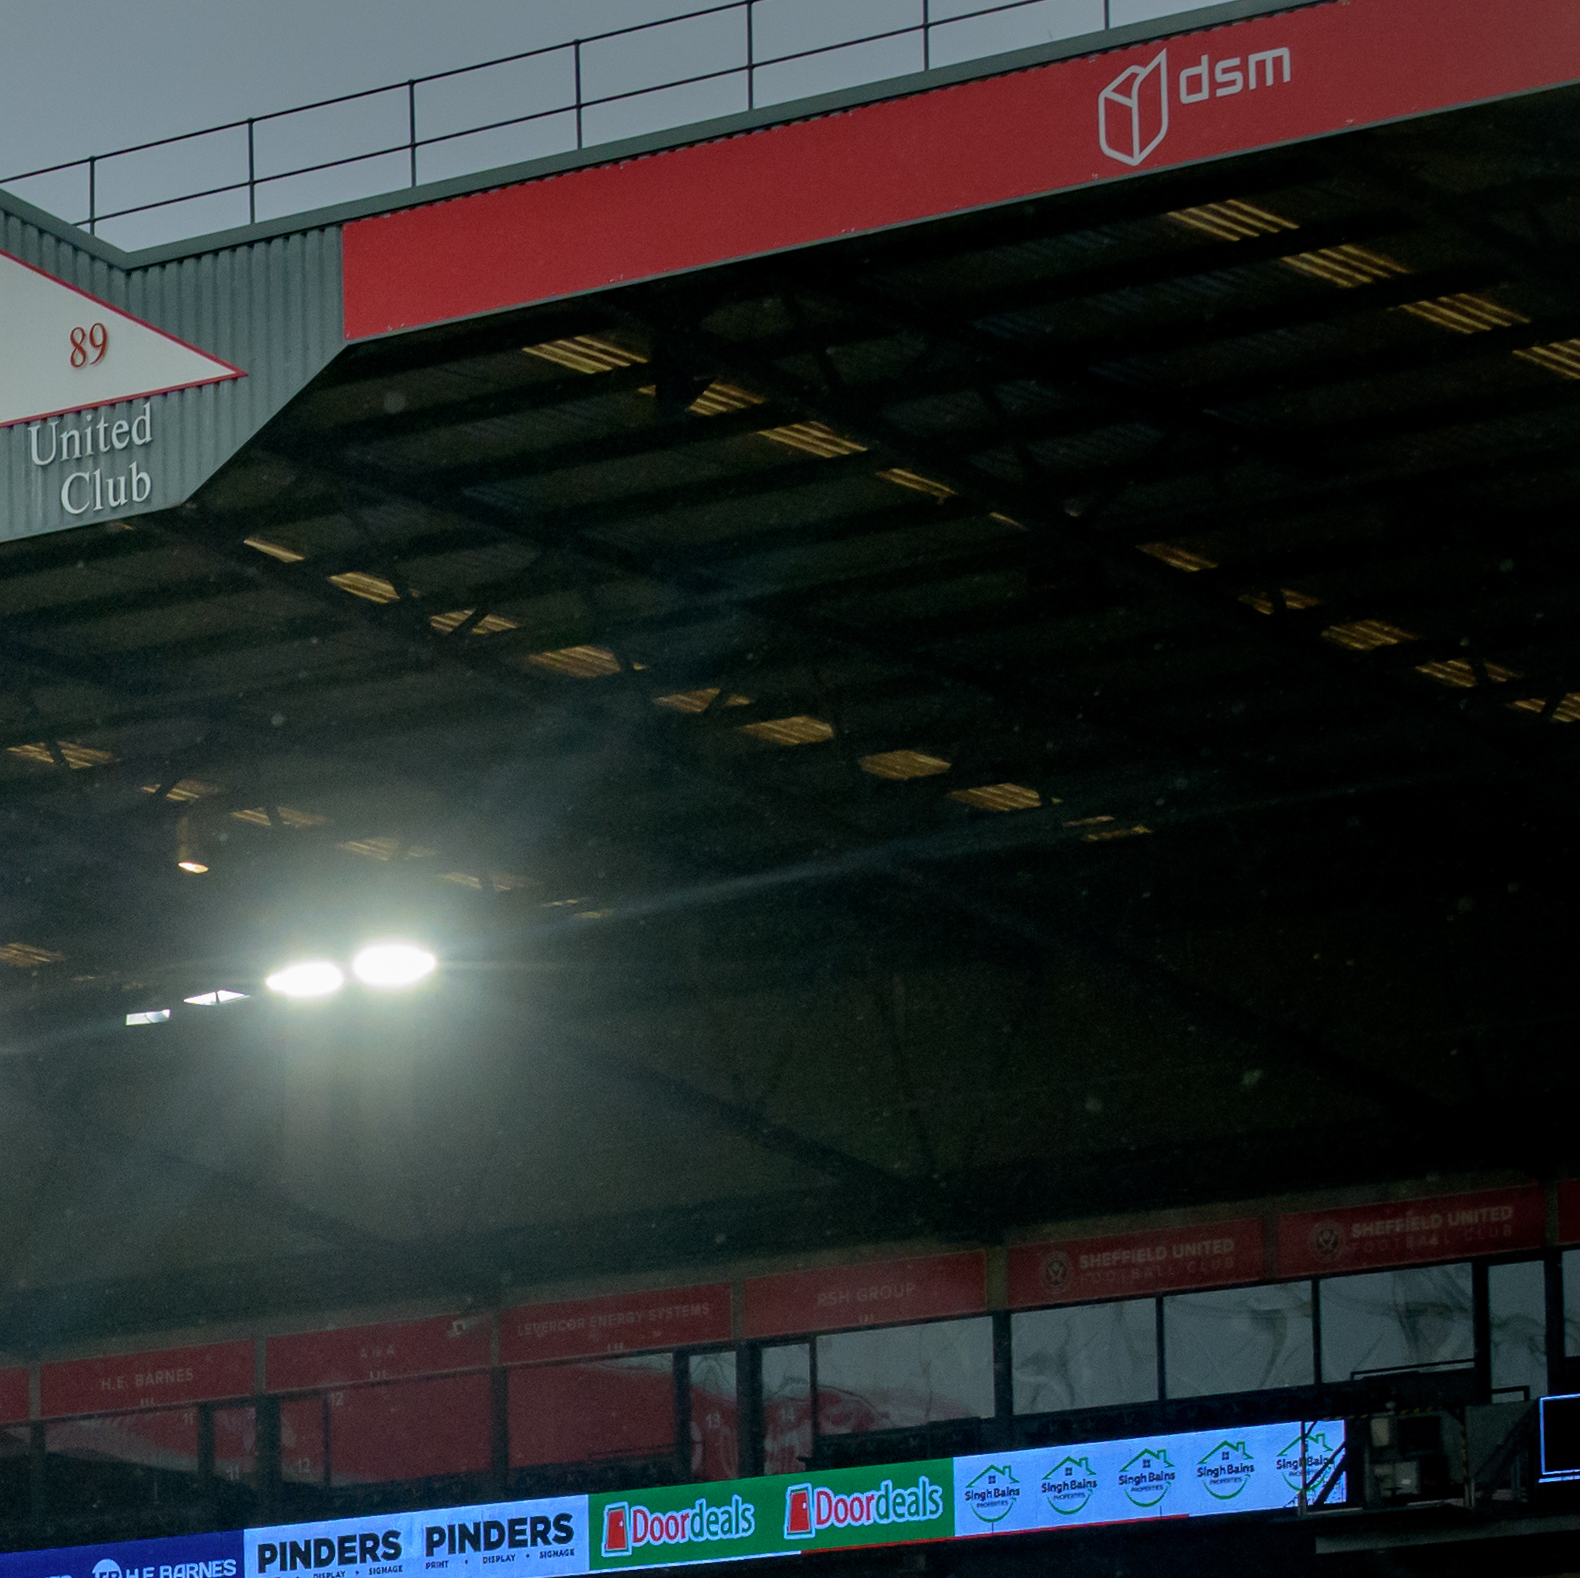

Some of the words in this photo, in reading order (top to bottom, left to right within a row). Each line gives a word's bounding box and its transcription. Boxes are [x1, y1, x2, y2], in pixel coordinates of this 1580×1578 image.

[1179, 47, 1291, 104] dsm
[69, 323, 109, 370] 89
[28, 402, 153, 467] United
[60, 462, 152, 515] Club
[1351, 1213, 1442, 1239] SHEFFIELD
[1448, 1205, 1513, 1227] UNITED
[1079, 1245, 1167, 1269] SHEFFIELD
[1172, 1237, 1234, 1259] UNITED
[135, 1367, 194, 1388] BARNES
[1041, 1481, 1069, 1494] Singh
[1069, 1478, 1097, 1490] Bains
[1118, 1473, 1147, 1487] Singh
[1148, 1470, 1175, 1482] Bains
[1197, 1465, 1226, 1479] Singh
[1227, 1462, 1254, 1474] Bains
[815, 1478, 941, 1526] Doordeals
[965, 1489, 992, 1502] Singh
[993, 1486, 1020, 1498] Bains
[425, 1513, 575, 1557] PINDERS
[632, 1498, 753, 1543] Doordeals
[258, 1530, 402, 1573] PINDERS
